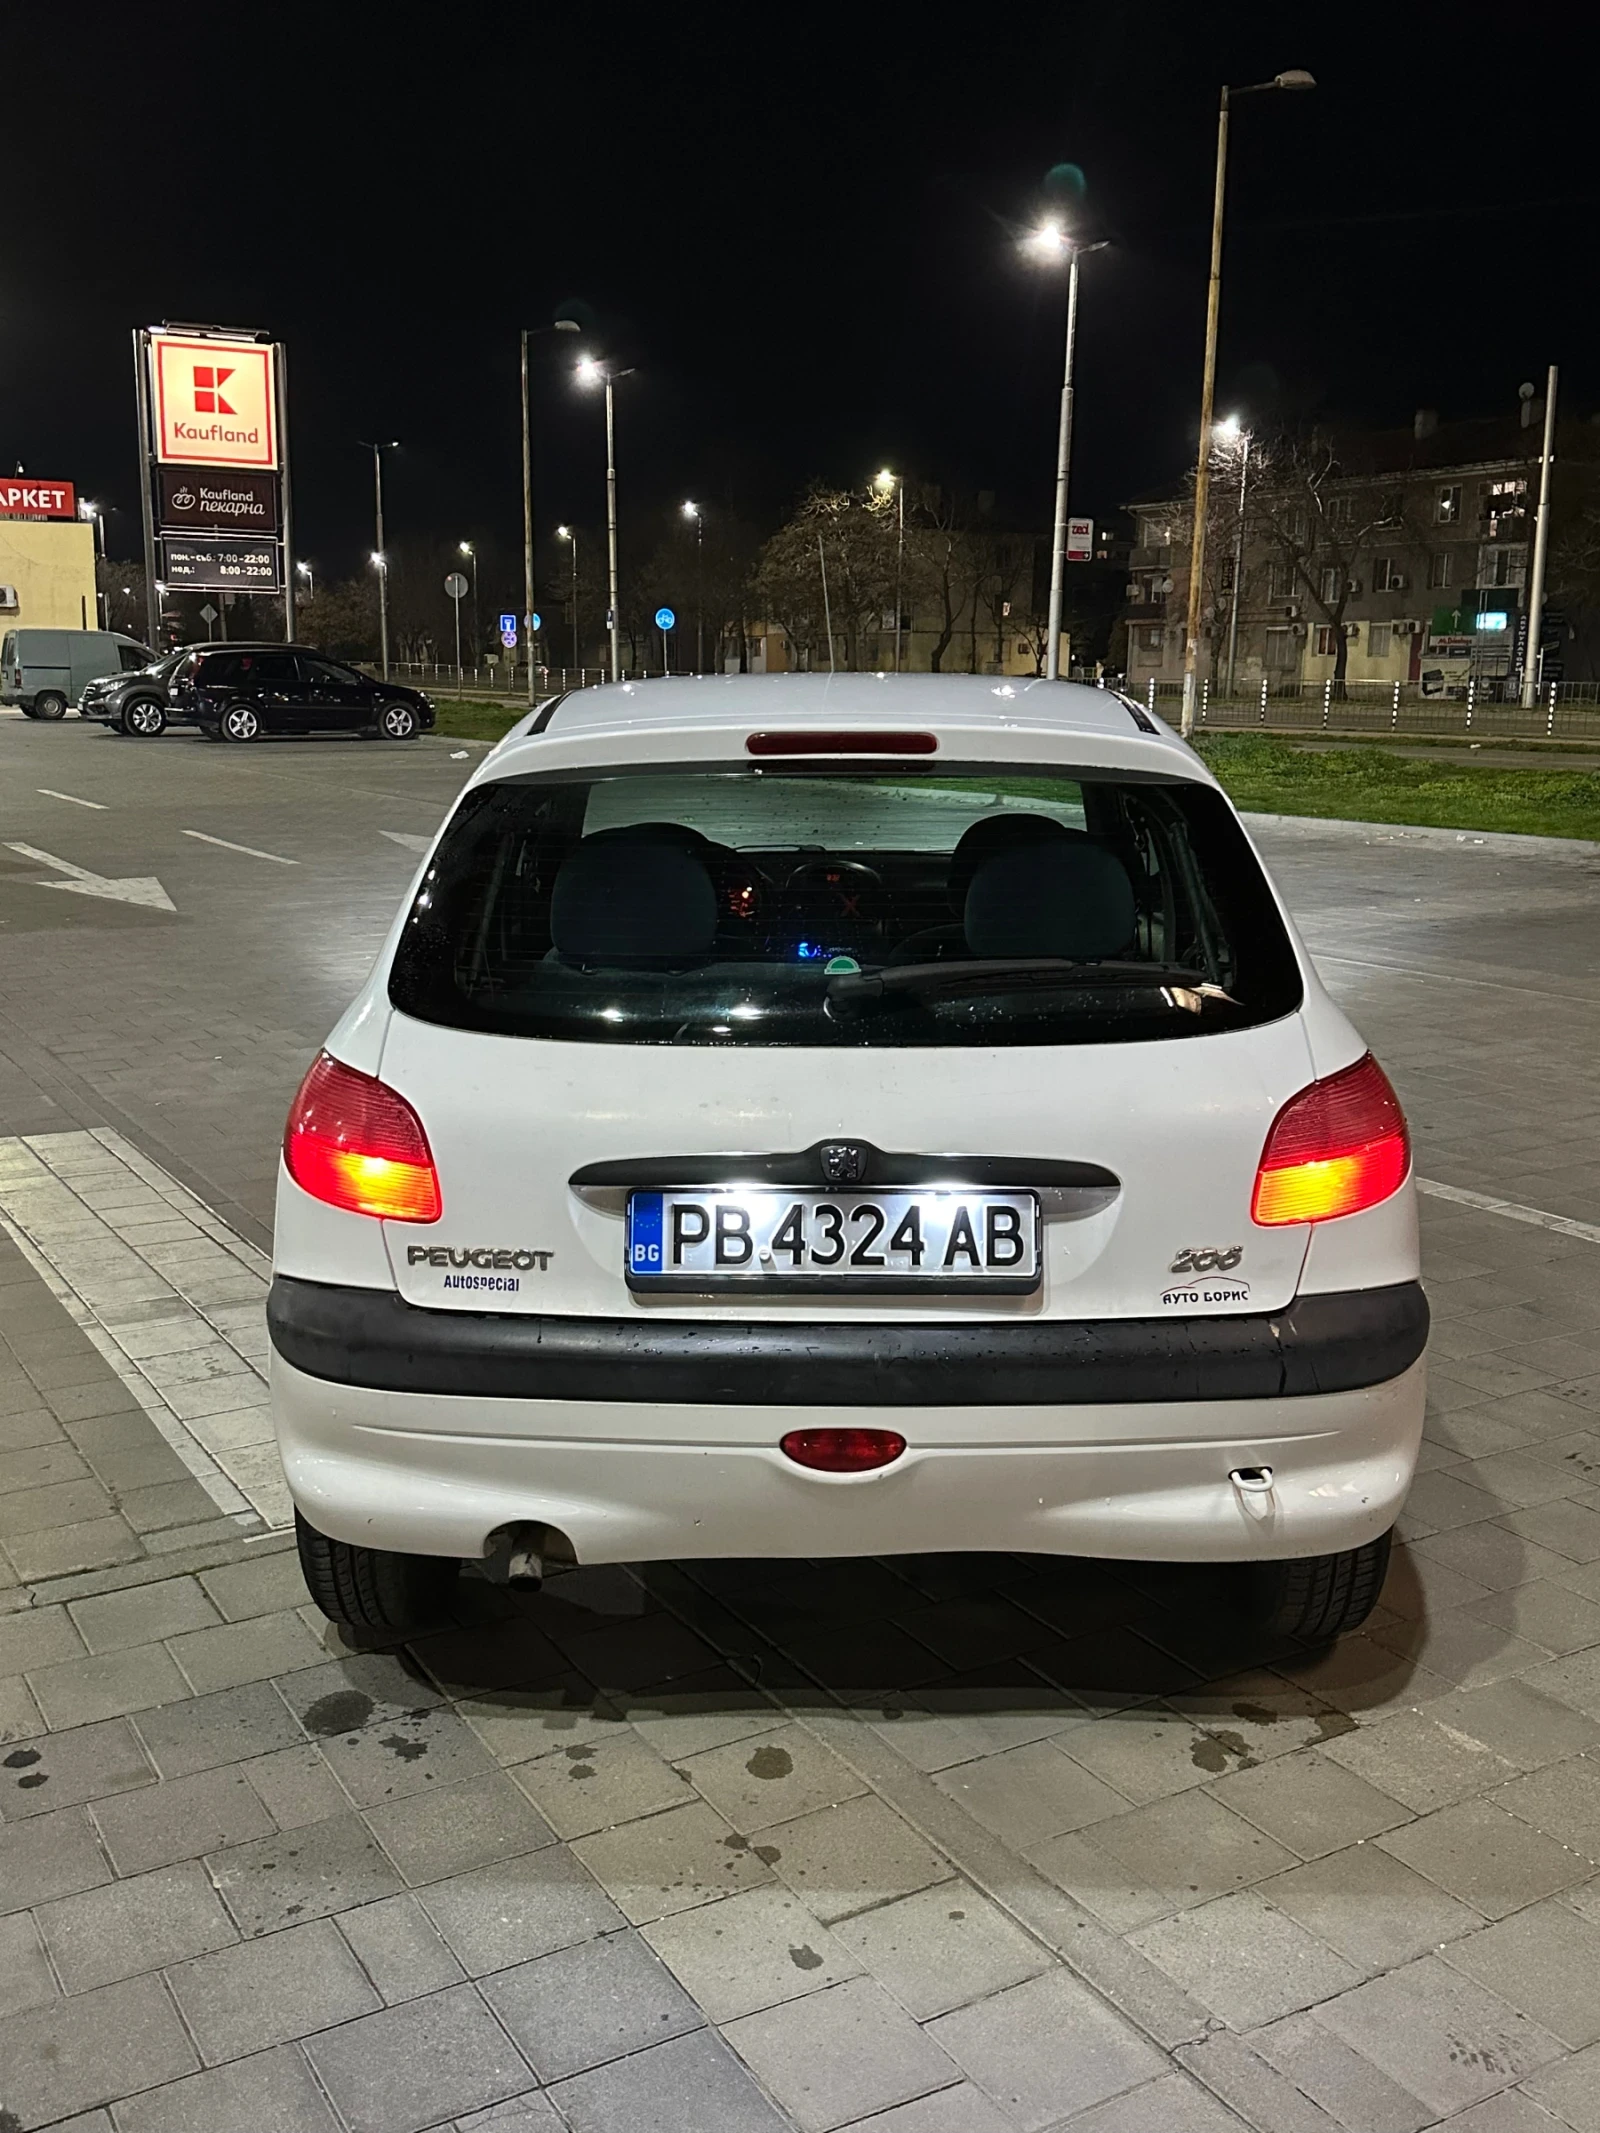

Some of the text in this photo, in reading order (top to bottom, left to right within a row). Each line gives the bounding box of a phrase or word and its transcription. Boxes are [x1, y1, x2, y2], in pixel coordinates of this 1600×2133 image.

[174, 422, 259, 444] Kaufland
[199, 487, 254, 502] Kaufland
[199, 500, 266, 516] пекарна
[671, 1203, 1025, 1267] PB 4324 AB
[407, 1245, 555, 1271] PEUGEOT
[633, 1244, 660, 1262] BG
[1168, 1245, 1243, 1273] 206
[443, 1275, 520, 1292] Autospecial
[1162, 1290, 1249, 1304] АУТО БОРИС
